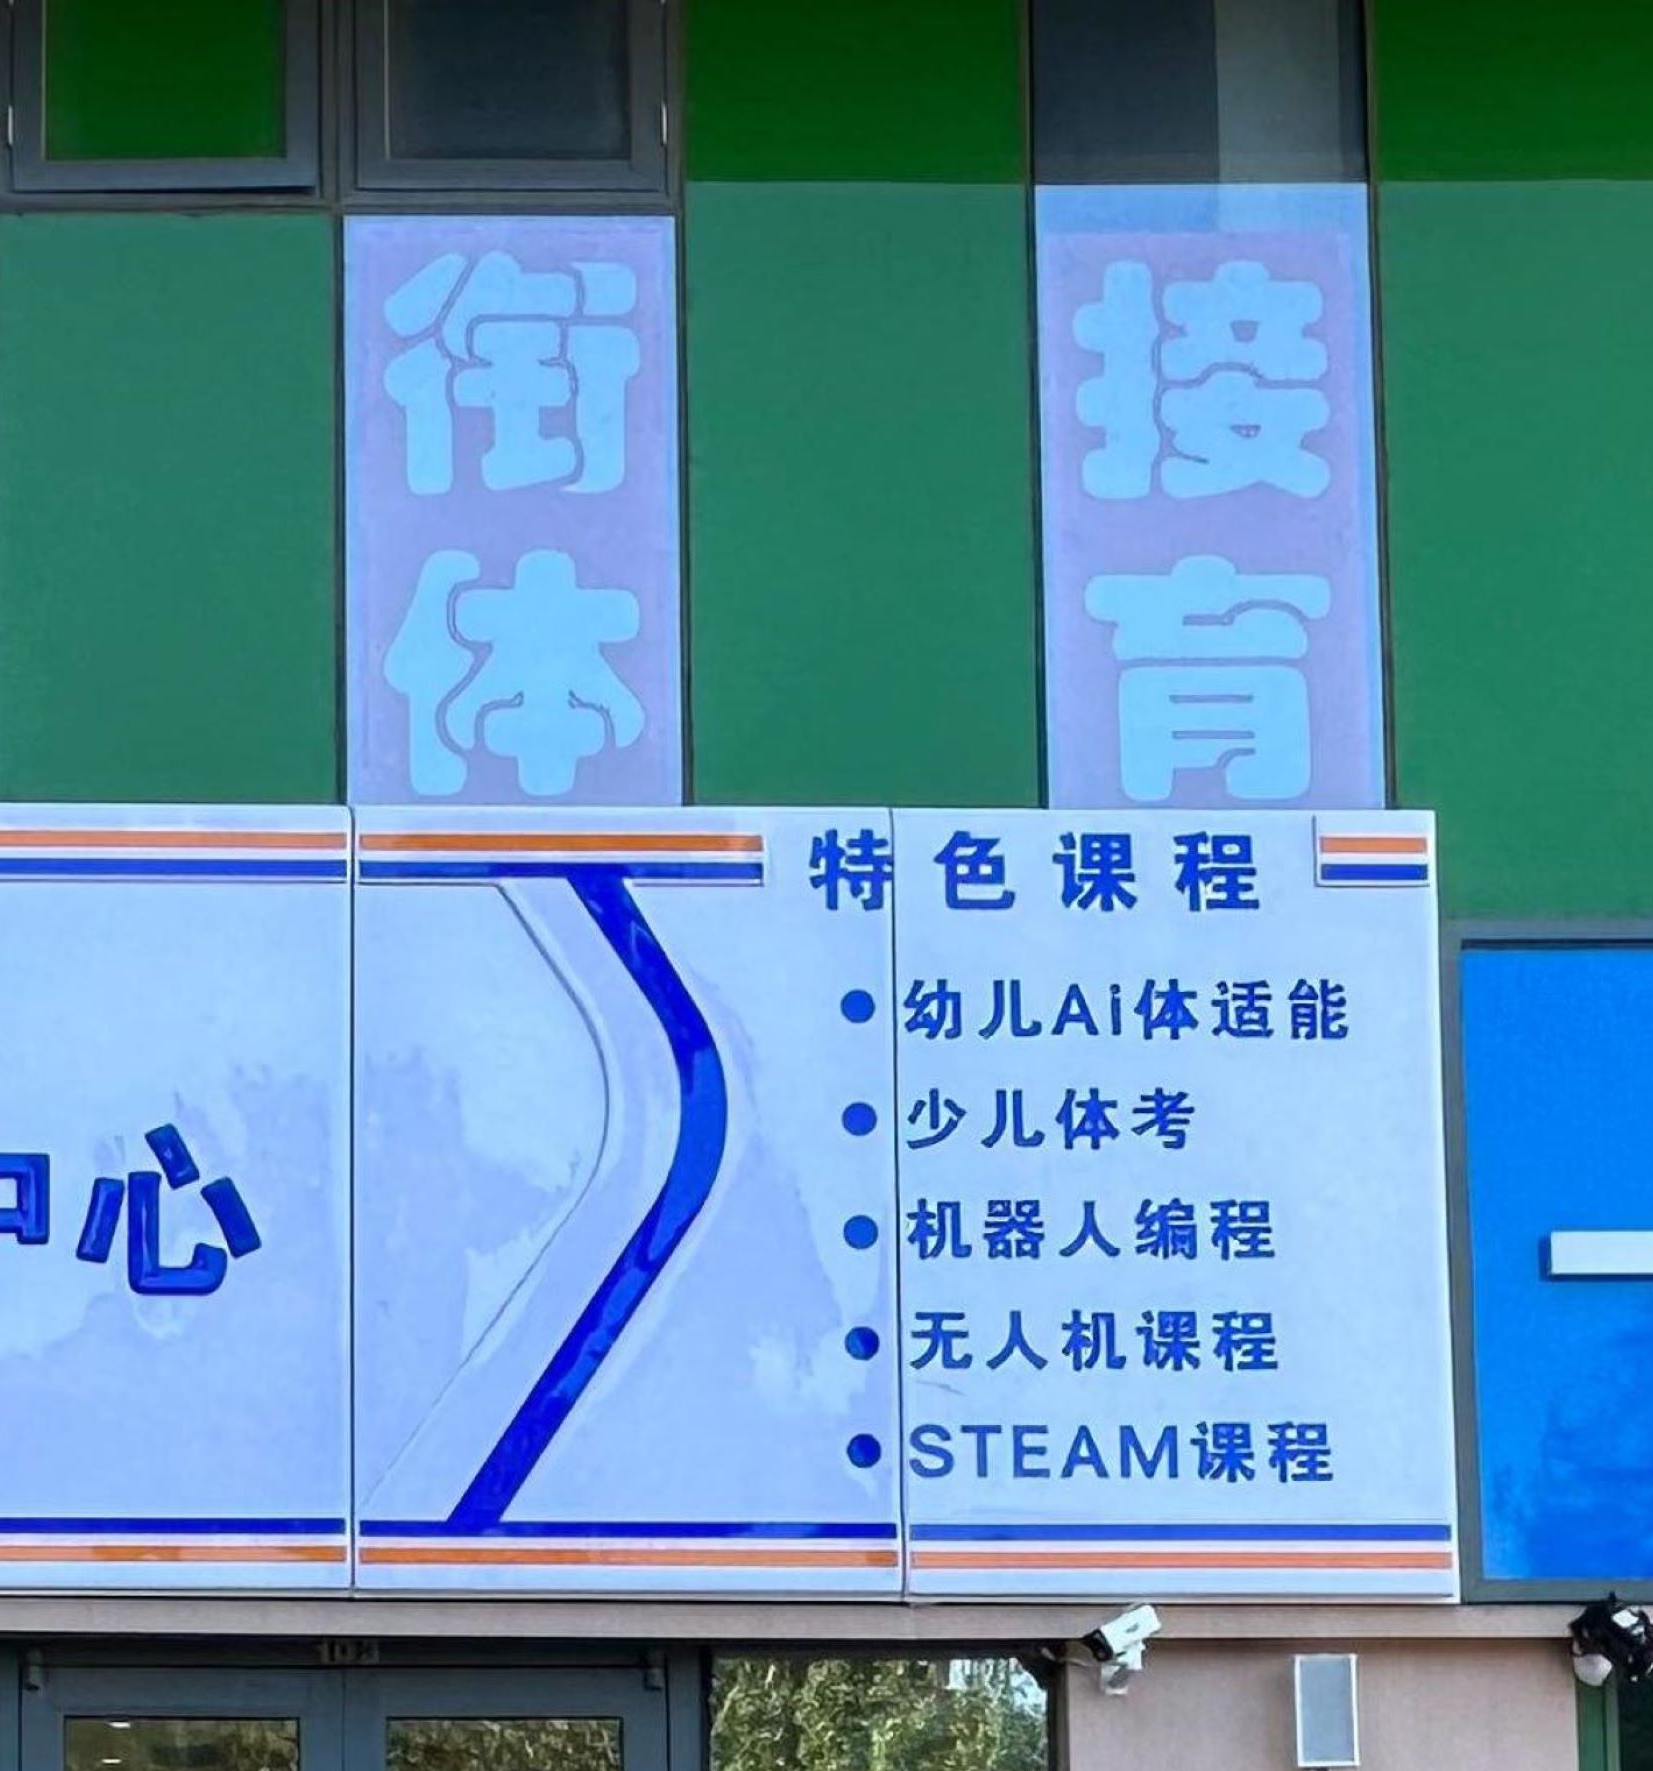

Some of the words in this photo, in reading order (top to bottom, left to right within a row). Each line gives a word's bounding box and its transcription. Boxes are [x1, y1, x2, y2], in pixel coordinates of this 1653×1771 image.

[810, 829, 1259, 912] 特色课程
[903, 978, 1349, 1040] 幼儿Ai体适能
[906, 1089, 1197, 1151] 少儿体考
[906, 1199, 1276, 1260] 机器人编程
[910, 1311, 1278, 1371] 无人机课程
[910, 1421, 1335, 1483] STEAM课程
